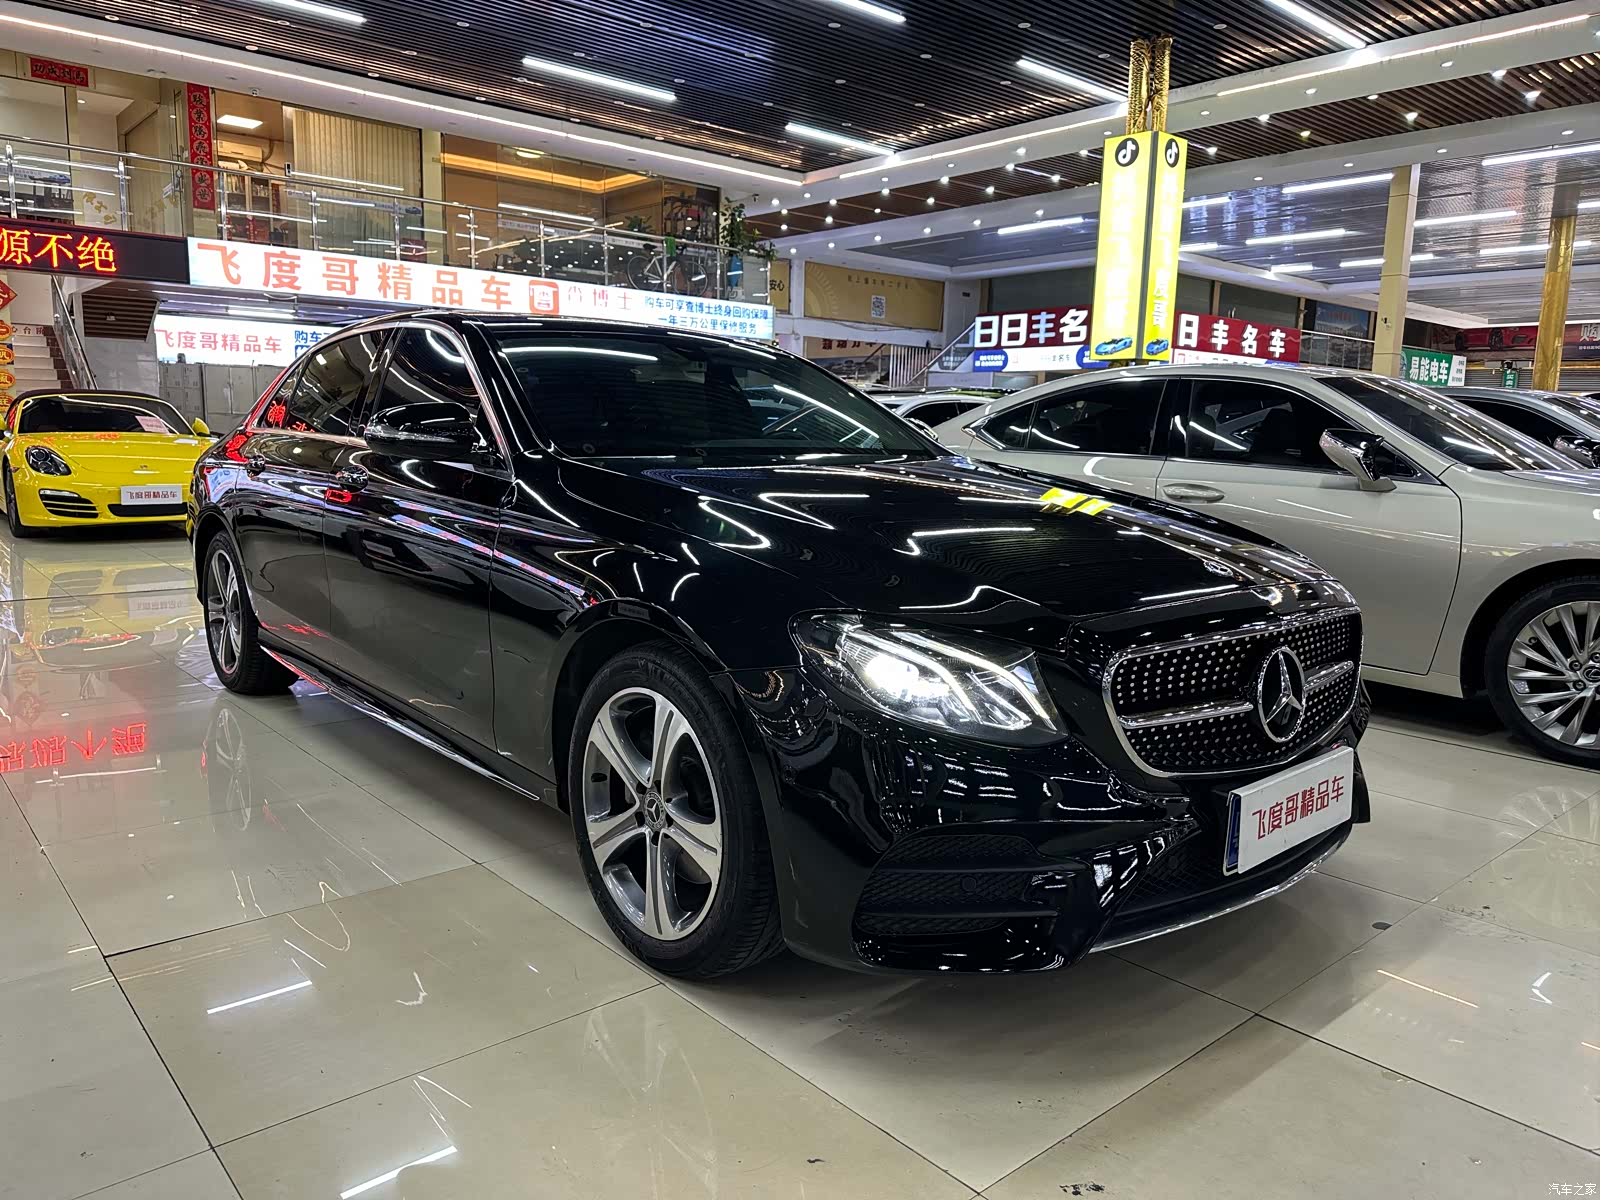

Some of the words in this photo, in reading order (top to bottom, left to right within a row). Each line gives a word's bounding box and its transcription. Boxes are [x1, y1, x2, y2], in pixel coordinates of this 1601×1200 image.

[197, 243, 512, 311] 飞度哥精品车
[154, 329, 282, 353] 飞度哥精品车
[294, 330, 330, 344] 购车
[1178, 313, 1286, 358] 日丰名车
[1410, 356, 1449, 383] 易能电车
[1252, 776, 1344, 839] 飞度哥精品车
